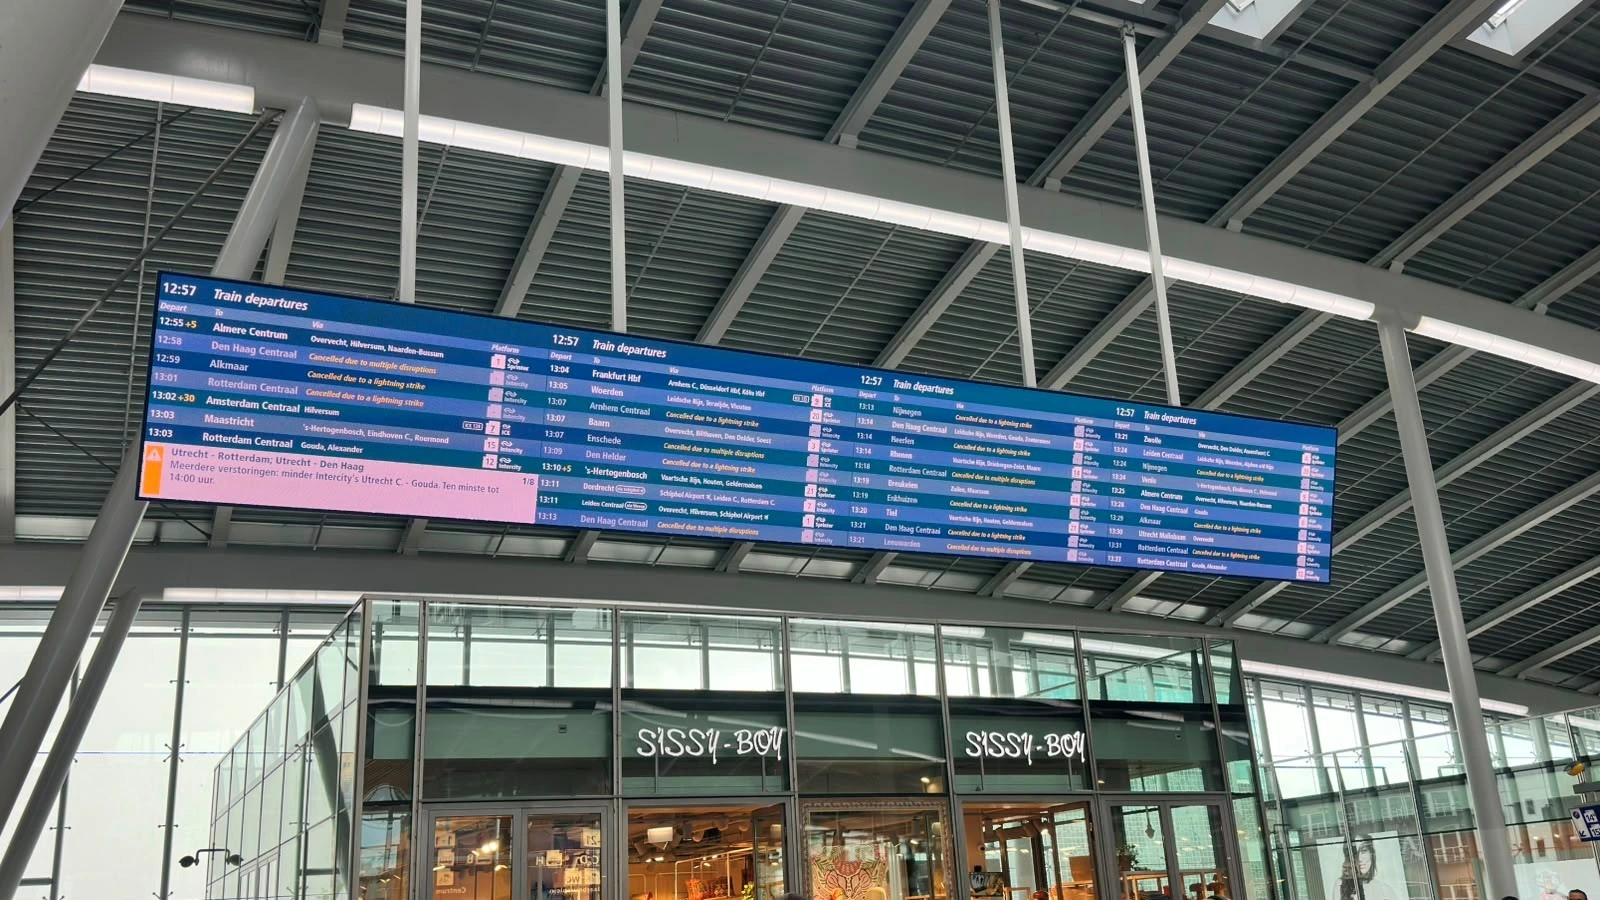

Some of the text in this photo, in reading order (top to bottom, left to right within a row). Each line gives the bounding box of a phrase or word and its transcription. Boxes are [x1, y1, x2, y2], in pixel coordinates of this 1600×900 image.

[164, 282, 196, 296] 12:57
[214, 289, 308, 311] Train departures
[160, 302, 187, 312] Depart
[160, 317, 197, 328] 12:55 +5
[213, 323, 288, 339] Almere Centrum
[158, 335, 182, 345] 12:58
[553, 334, 579, 346] 12:57
[212, 341, 297, 359] Den Haag Centraal
[311, 335, 444, 358] Overvecht, Hilversum, Naarden-Bussum
[491, 344, 519, 353] Platform
[593, 339, 667, 358] Train departures
[157, 354, 180, 363] 12:59
[550, 352, 572, 360] Depart
[210, 359, 248, 371] Alkmaar
[309, 353, 344, 363] Cancelled
[345, 357, 358, 365] due
[369, 361, 398, 370] multiple
[399, 363, 436, 374] disruptions
[550, 364, 569, 373] 13:04
[155, 372, 178, 382] 13:01
[307, 371, 343, 381] Cancelled
[373, 378, 405, 389] lightning
[406, 382, 426, 390] strike
[593, 370, 641, 382] Frankfurt Hbf
[861, 375, 882, 385] 12:57
[208, 377, 298, 394] Rotterdam Centraal
[549, 381, 568, 389] 13:05
[893, 379, 954, 395] Train departures
[153, 391, 195, 402] 13:02 +30
[591, 386, 623, 396] Woerden
[306, 388, 341, 398] Cancelled
[342, 392, 356, 400] due
[372, 395, 404, 406] lightning
[548, 397, 567, 406] 13:07
[206, 396, 300, 413] Amsterdam Centraal
[589, 402, 650, 415] Arnhem Centraal
[151, 409, 174, 419] 13:03
[304, 406, 339, 415] Hilversum
[1116, 407, 1135, 417] 12:57
[205, 414, 254, 427] Maastricht
[547, 414, 565, 422] 13:07
[589, 418, 610, 427] Baarn
[1144, 411, 1197, 425] Train departures
[149, 428, 173, 437] 13:03
[892, 421, 947, 433] Den Haag Centraal
[303, 424, 365, 437] 's-Hertogenbosch,
[368, 430, 403, 439] Eindhoven
[415, 434, 449, 444] Roermond
[545, 430, 564, 438] 13:07
[587, 434, 621, 445] Enschede
[203, 432, 293, 448] Rotterdam Centraal
[486, 441, 497, 450] 15
[301, 442, 363, 453] Gouda, Alexander
[544, 446, 562, 455] 13:09
[586, 450, 626, 461] Den Helder
[1143, 449, 1183, 460] Leiden Centraal
[172, 448, 364, 473] Utrecht Rotterdam; Utrecht Den Haag
[484, 458, 495, 467] 12
[542, 463, 561, 471] 13:10
[585, 466, 647, 479] 's-Hertogenbosch
[889, 465, 947, 477] Rotterdam Centraal
[170, 460, 215, 472] Meerdere
[218, 466, 279, 477] verstoringen:
[281, 470, 313, 479] minder
[316, 472, 359, 484] Intercity's
[362, 476, 393, 485] Utrecht
[396, 478, 403, 486] C.
[411, 480, 440, 488] Gouda.
[442, 482, 456, 490] Ten
[458, 484, 485, 492] minste
[170, 473, 195, 483] 14:00
[541, 479, 559, 487] 13:11
[583, 483, 614, 492] Dordrecht
[660, 490, 705, 500] Schiphol Airport
[852, 506, 867, 514] 13:20
[1152, 504, 1165, 513] Haag
[1166, 506, 1188, 514] Centraal
[538, 512, 557, 520] 13:13
[580, 515, 648, 527] Den Haag Centraal
